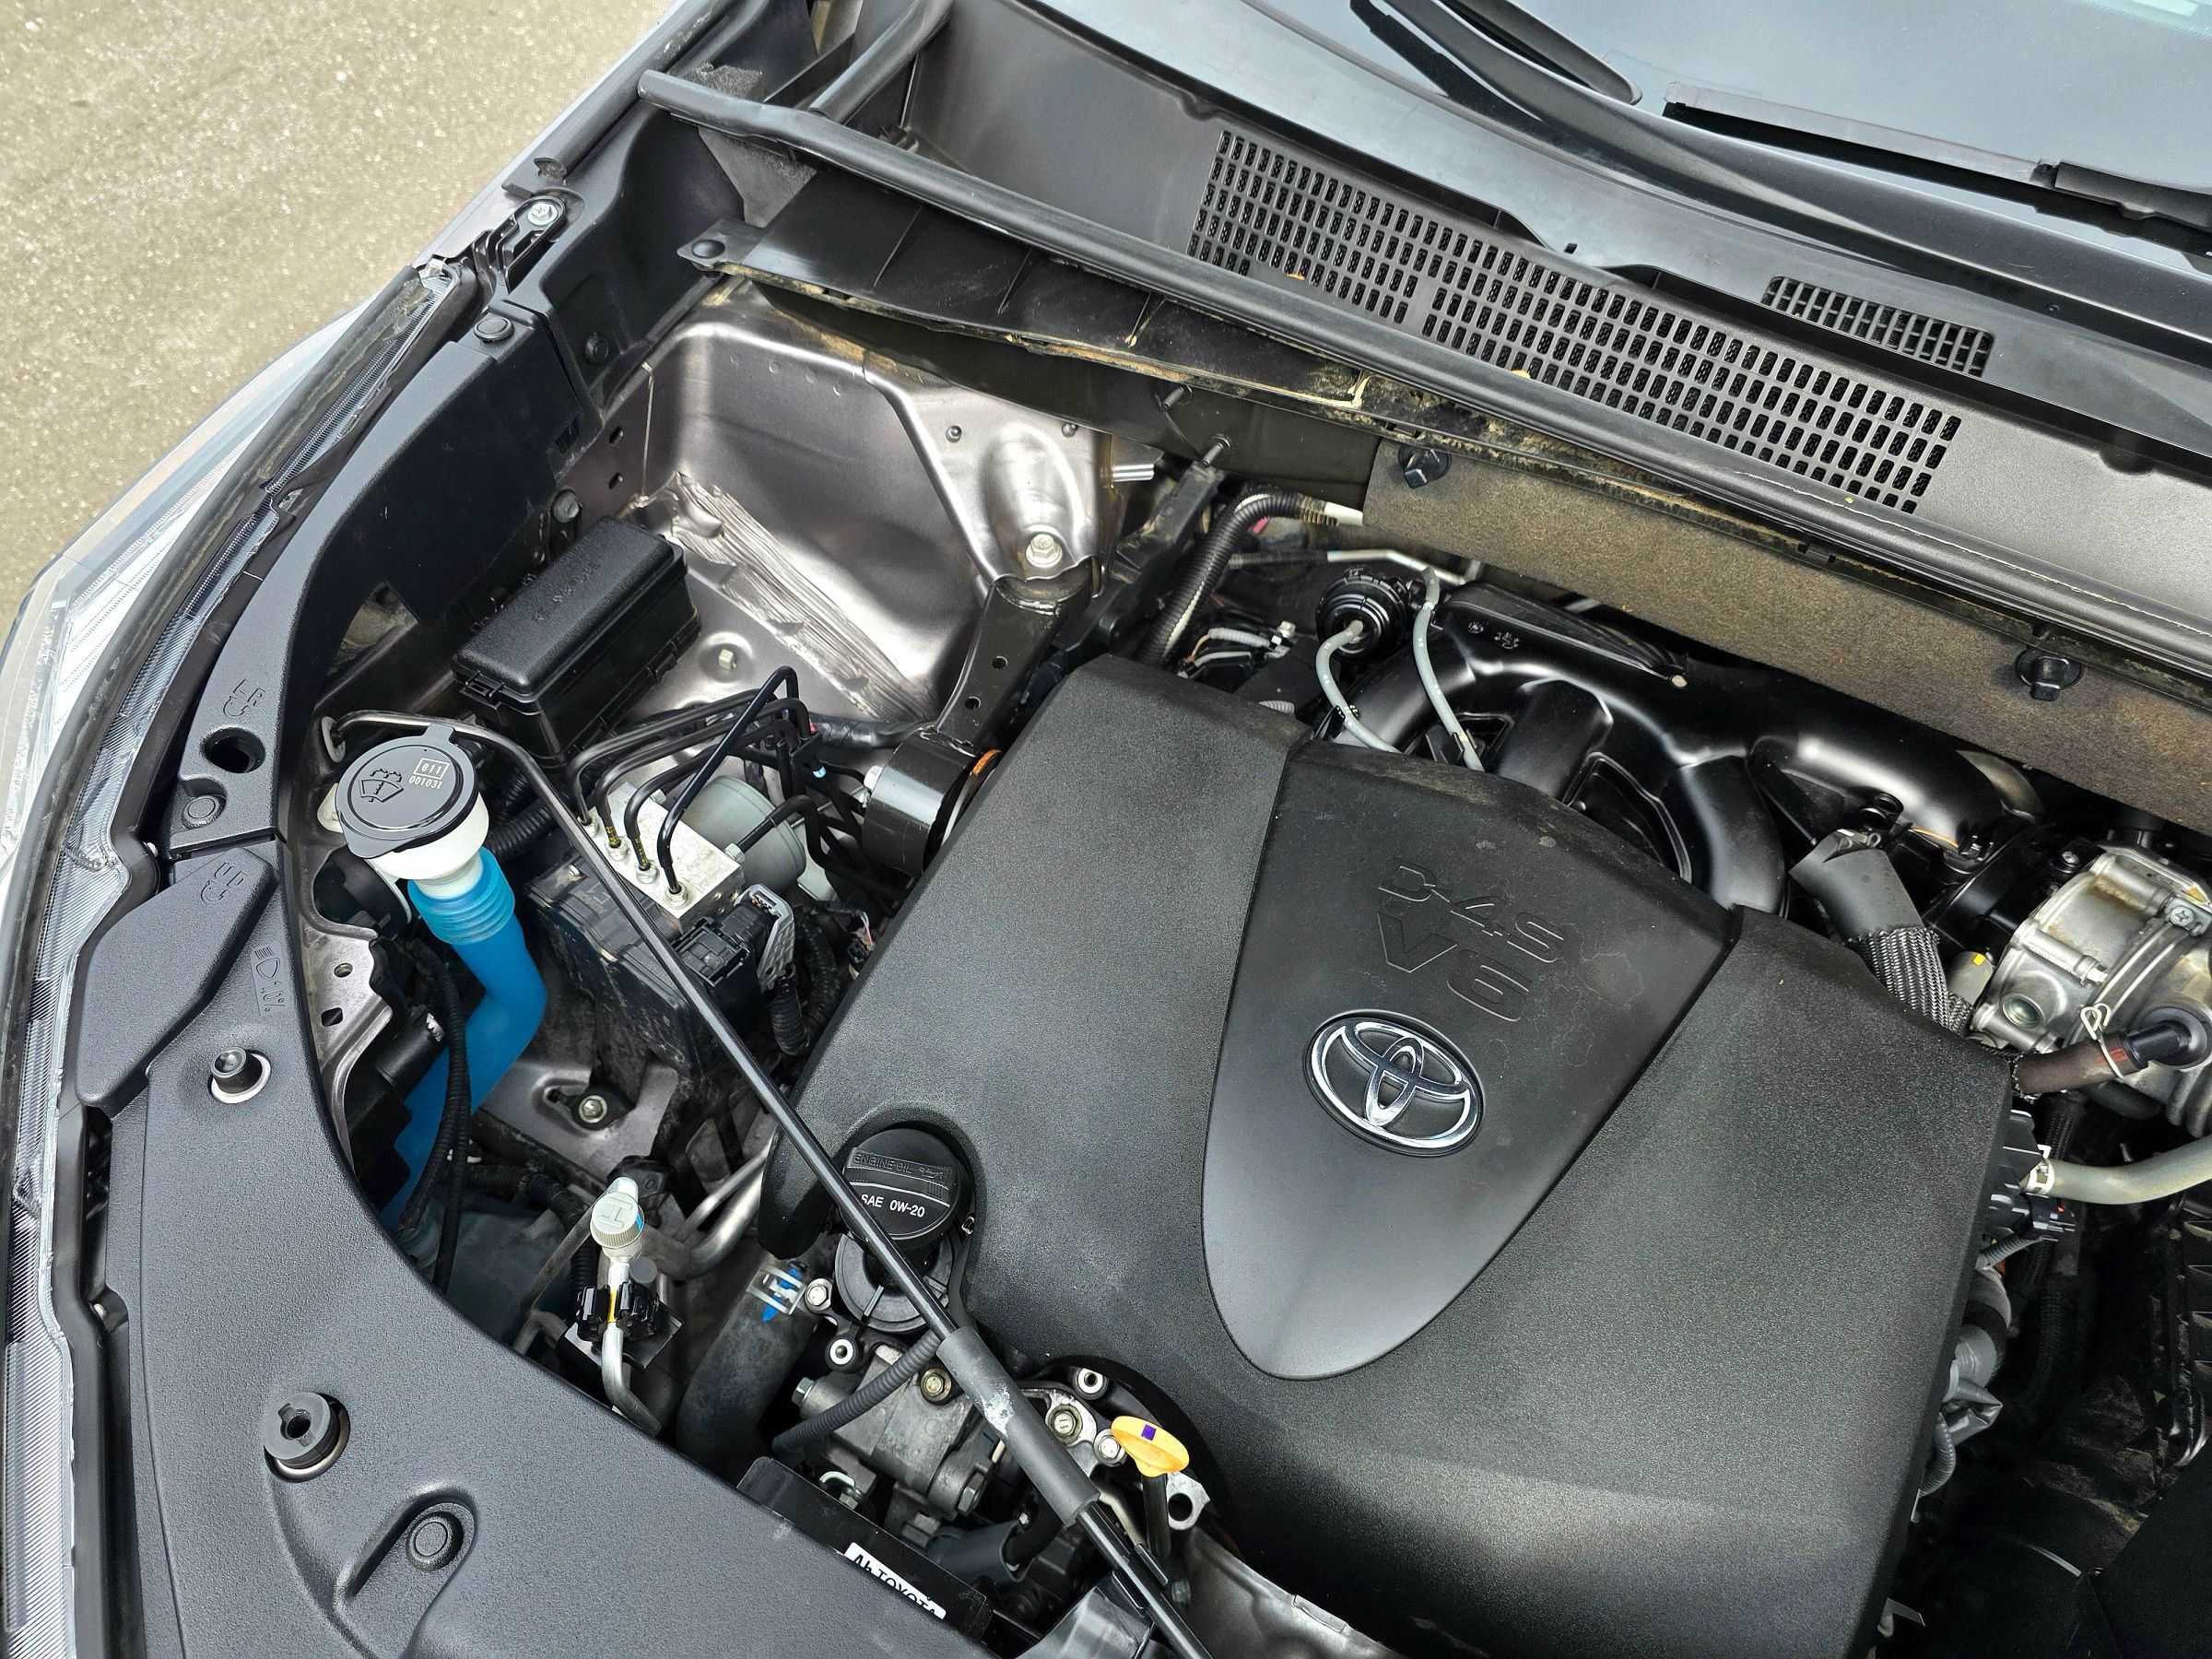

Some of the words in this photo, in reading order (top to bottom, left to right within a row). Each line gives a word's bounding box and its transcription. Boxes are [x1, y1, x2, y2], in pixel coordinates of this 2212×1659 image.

[1377, 912, 1534, 1022] V6
[853, 1153, 895, 1170] ENGINE
[896, 1162, 912, 1174] OIL
[861, 1194, 884, 1207] SAE
[889, 1199, 925, 1218] 0W-20
